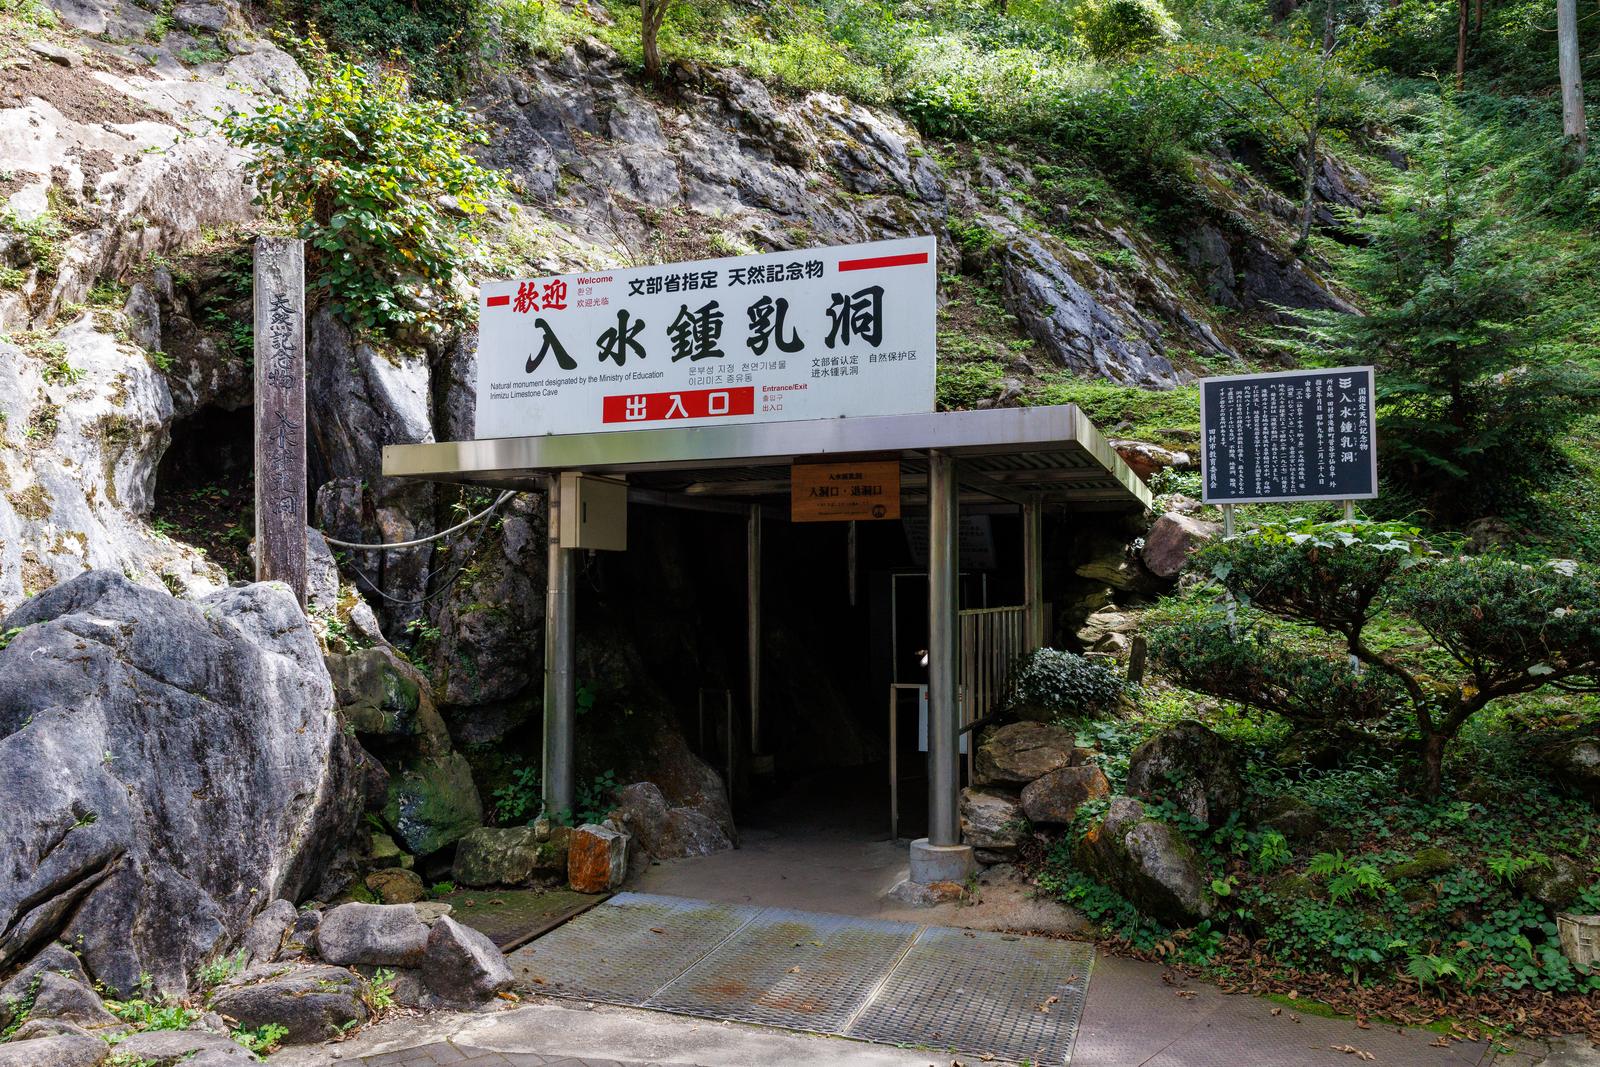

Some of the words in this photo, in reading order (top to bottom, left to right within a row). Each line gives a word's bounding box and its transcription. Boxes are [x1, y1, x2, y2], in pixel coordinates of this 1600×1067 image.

[577, 275, 613, 285] Welcome
[628, 270, 718, 297] 文部省指定
[728, 259, 824, 287] 天然記念物
[525, 285, 885, 374] 入水鍾乳洞
[811, 355, 859, 368] 文部省认定
[869, 350, 917, 363] 自然保护区
[490, 381, 512, 391] Natural
[513, 378, 544, 389] monument
[545, 376, 578, 389] designated
[579, 375, 587, 385] by
[588, 374, 598, 383] the
[599, 372, 623, 384] Ministry
[624, 371, 632, 379] of
[633, 369, 664, 379] Education
[762, 382, 808, 393] Entrance/Exit
[1326, 378, 1335, 398] 所在地
[490, 391, 509, 400] Irimizu
[511, 389, 541, 399] Limestone
[542, 388, 558, 397] Cave
[625, 391, 730, 421] 出入口
[762, 404, 783, 412] 出入口
[1358, 387, 1369, 451] 国指定天然記念物
[1208, 428, 1218, 489] 田村市教育委員会
